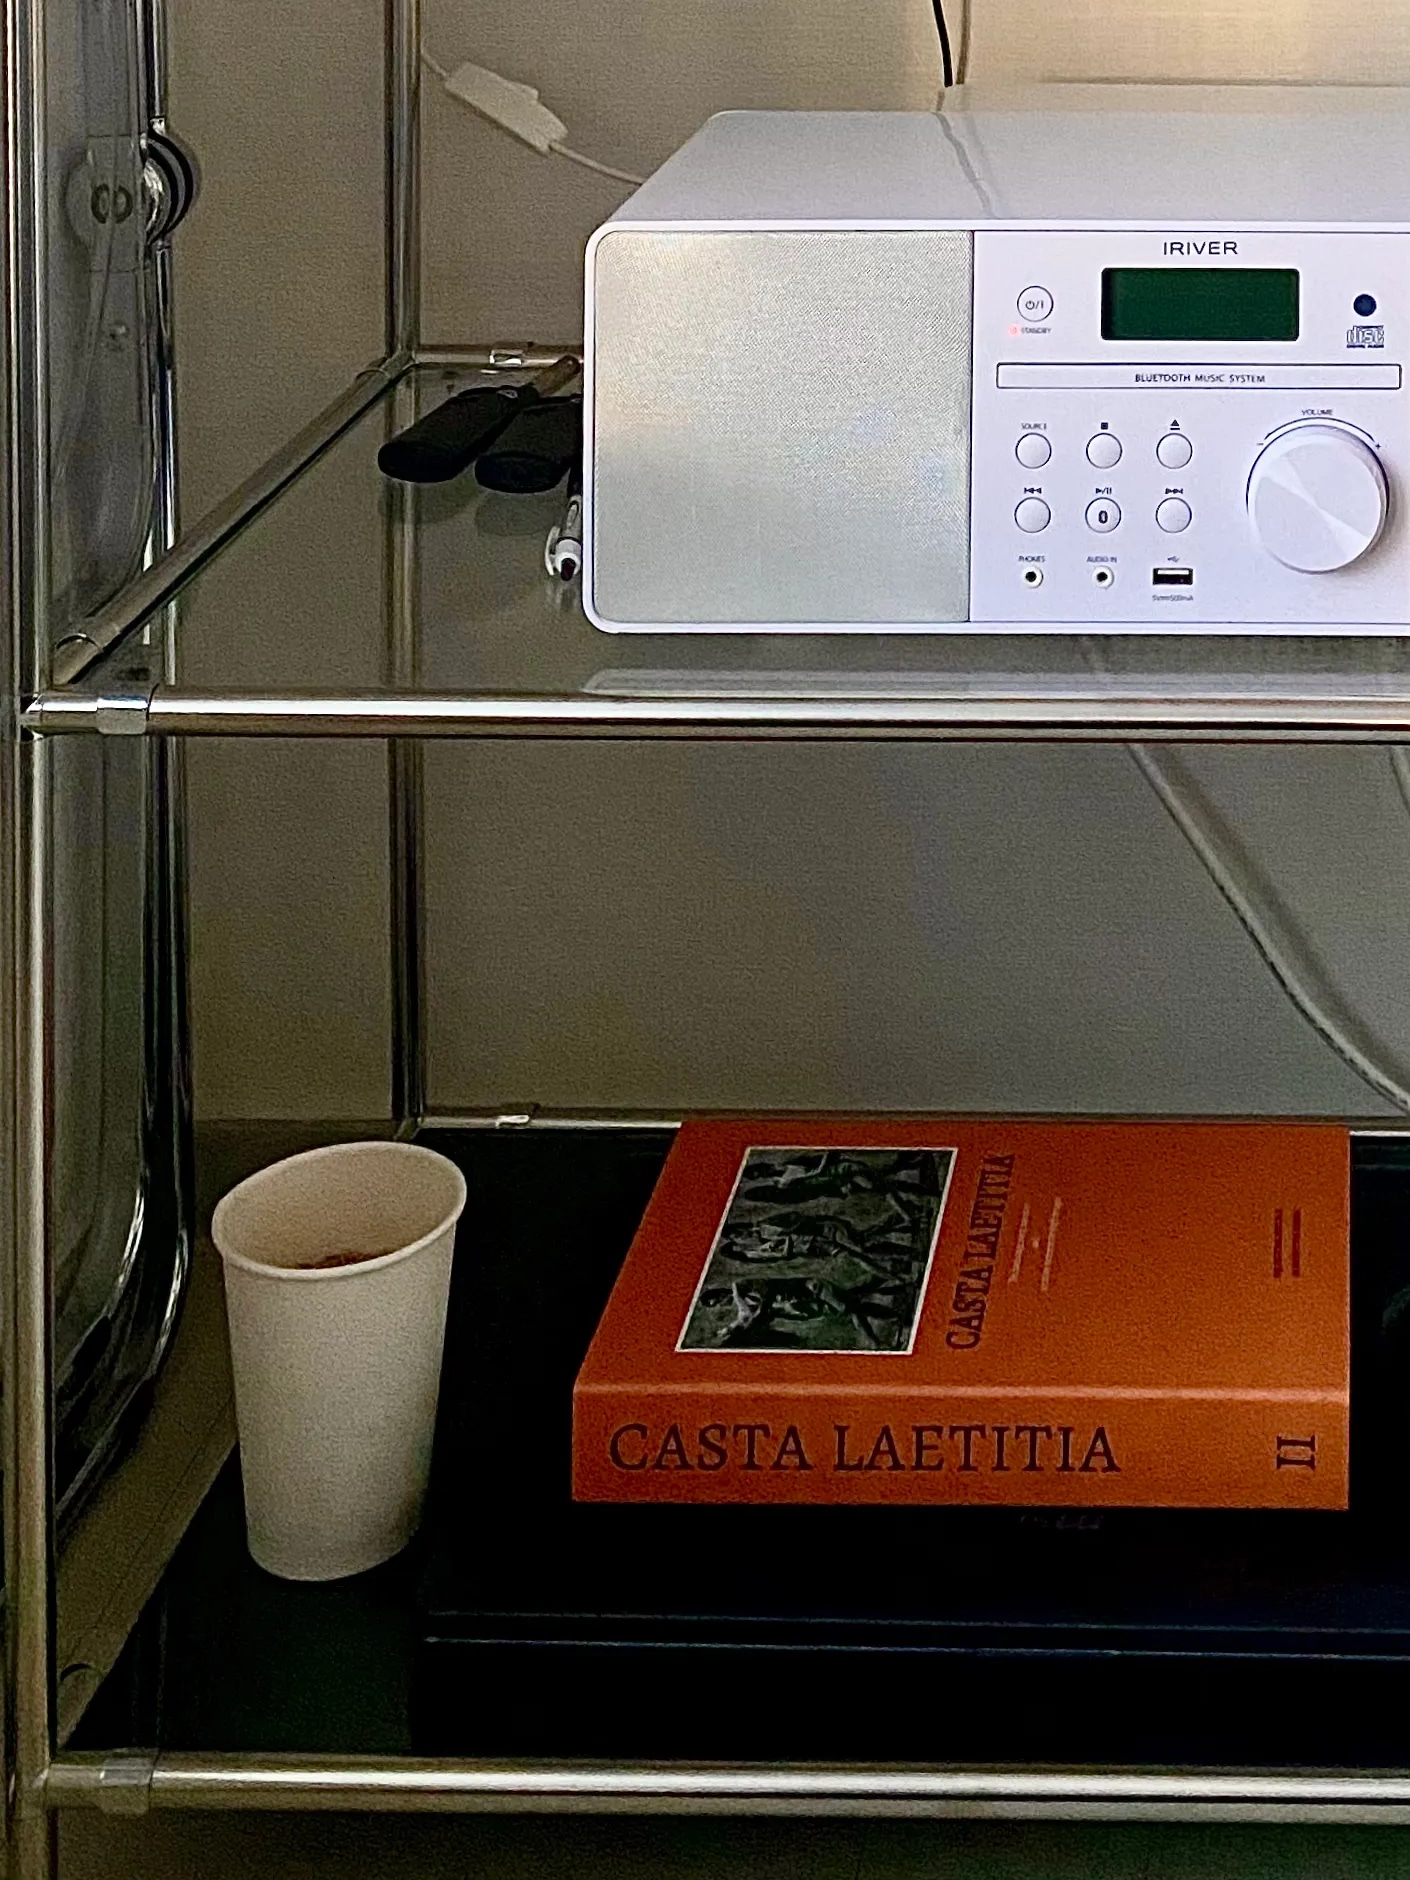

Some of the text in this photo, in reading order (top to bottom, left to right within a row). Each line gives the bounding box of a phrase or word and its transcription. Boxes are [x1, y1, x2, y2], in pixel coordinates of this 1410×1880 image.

[1163, 241, 1239, 256] IRIVER
[1134, 373, 1266, 383] BLUETOOTH MUSIC SYSTEM
[1018, 555, 1046, 563] PHONES
[945, 1153, 1016, 1350] CASTA LAETITIA
[608, 1422, 813, 1473] CASTA
[832, 1424, 1122, 1474] LAETITIA
